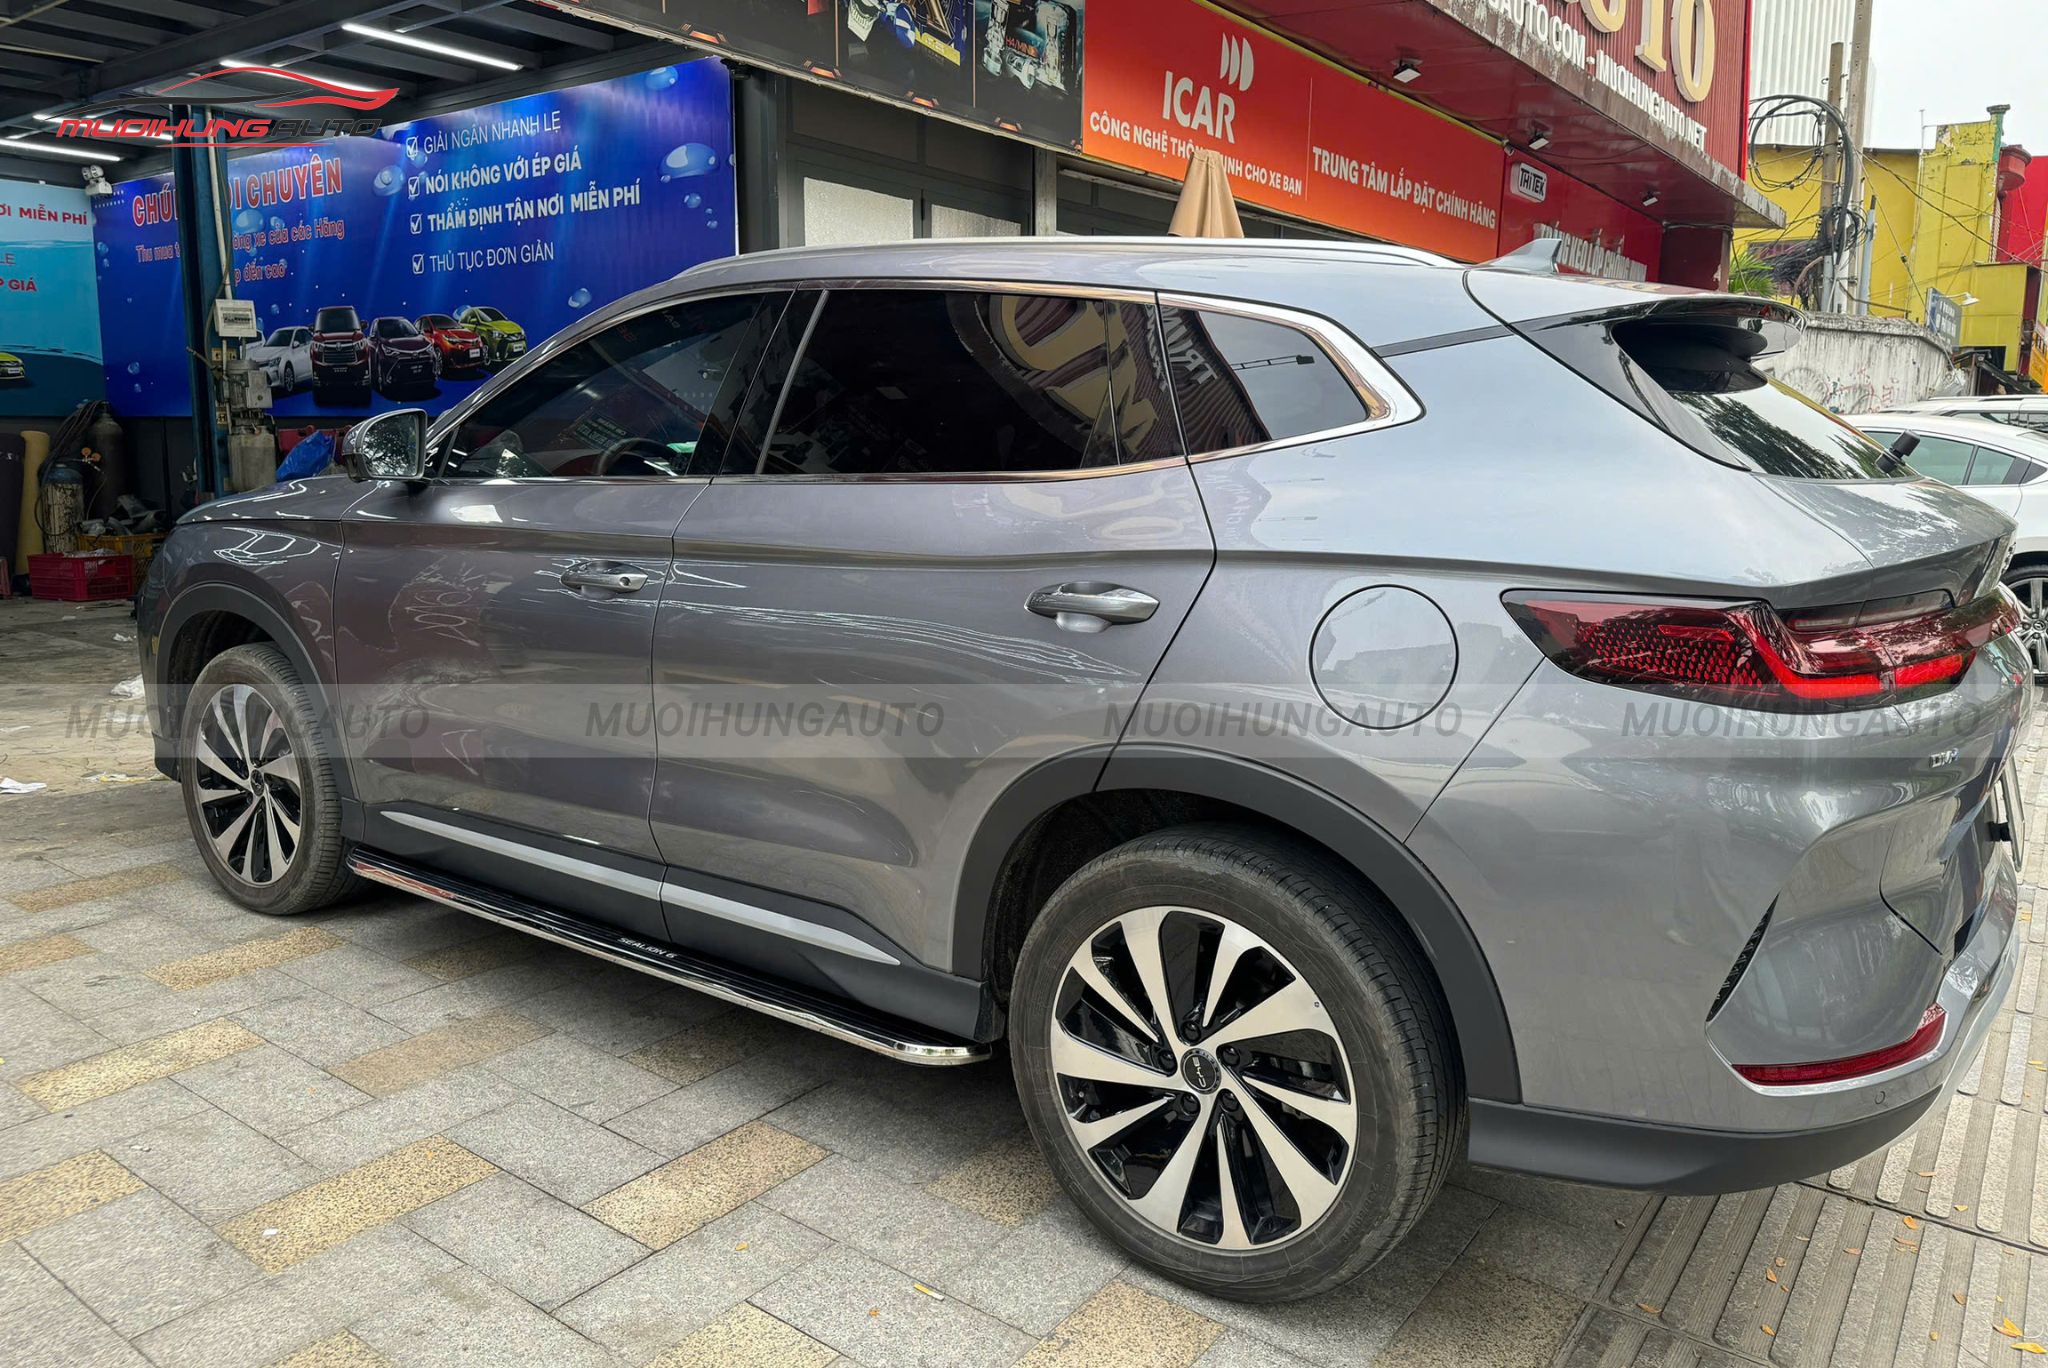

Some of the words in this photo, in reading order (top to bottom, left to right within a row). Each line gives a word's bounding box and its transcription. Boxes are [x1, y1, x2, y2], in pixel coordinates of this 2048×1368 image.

[1162, 70, 1236, 144] ICAR
[424, 131, 448, 154] GIẢI
[451, 125, 488, 149] NGÂN
[492, 115, 540, 142] NHANH
[1089, 110, 1130, 141] CÔNG
[1133, 125, 1168, 158] NGHỆ
[1245, 163, 1267, 185] CHO
[1269, 170, 1281, 189] XE
[1283, 175, 1302, 199] BẠN
[246, 153, 343, 209] CHUYÊN
[426, 168, 449, 194] NÓI
[452, 161, 500, 190] KHÔNG
[503, 155, 529, 182] VỚI
[532, 152, 551, 177] ÉP
[554, 145, 582, 173] GIÁ
[1313, 146, 1359, 185] TRUNG
[1361, 161, 1388, 194] TÂM
[1390, 167, 1412, 201] LẮP
[1413, 180, 1435, 214] ĐẶT
[1436, 190, 1469, 220] CHÍNH
[19, 204, 58, 222] MIỄN
[62, 211, 88, 225] PHÍ
[428, 202, 467, 232] THẨM
[469, 205, 502, 231] ĐỊNH
[505, 197, 534, 226] TẬN
[537, 195, 564, 217] NƠI
[571, 180, 609, 212] MIỄN
[613, 178, 641, 205] PHÍ
[430, 249, 454, 272] THỦ
[458, 251, 484, 272] TỤC
[486, 245, 517, 267] ĐƠN
[521, 239, 554, 264] GIẢN
[8, 277, 37, 292] GIÁ
[617, 937, 667, 955] SEALION
